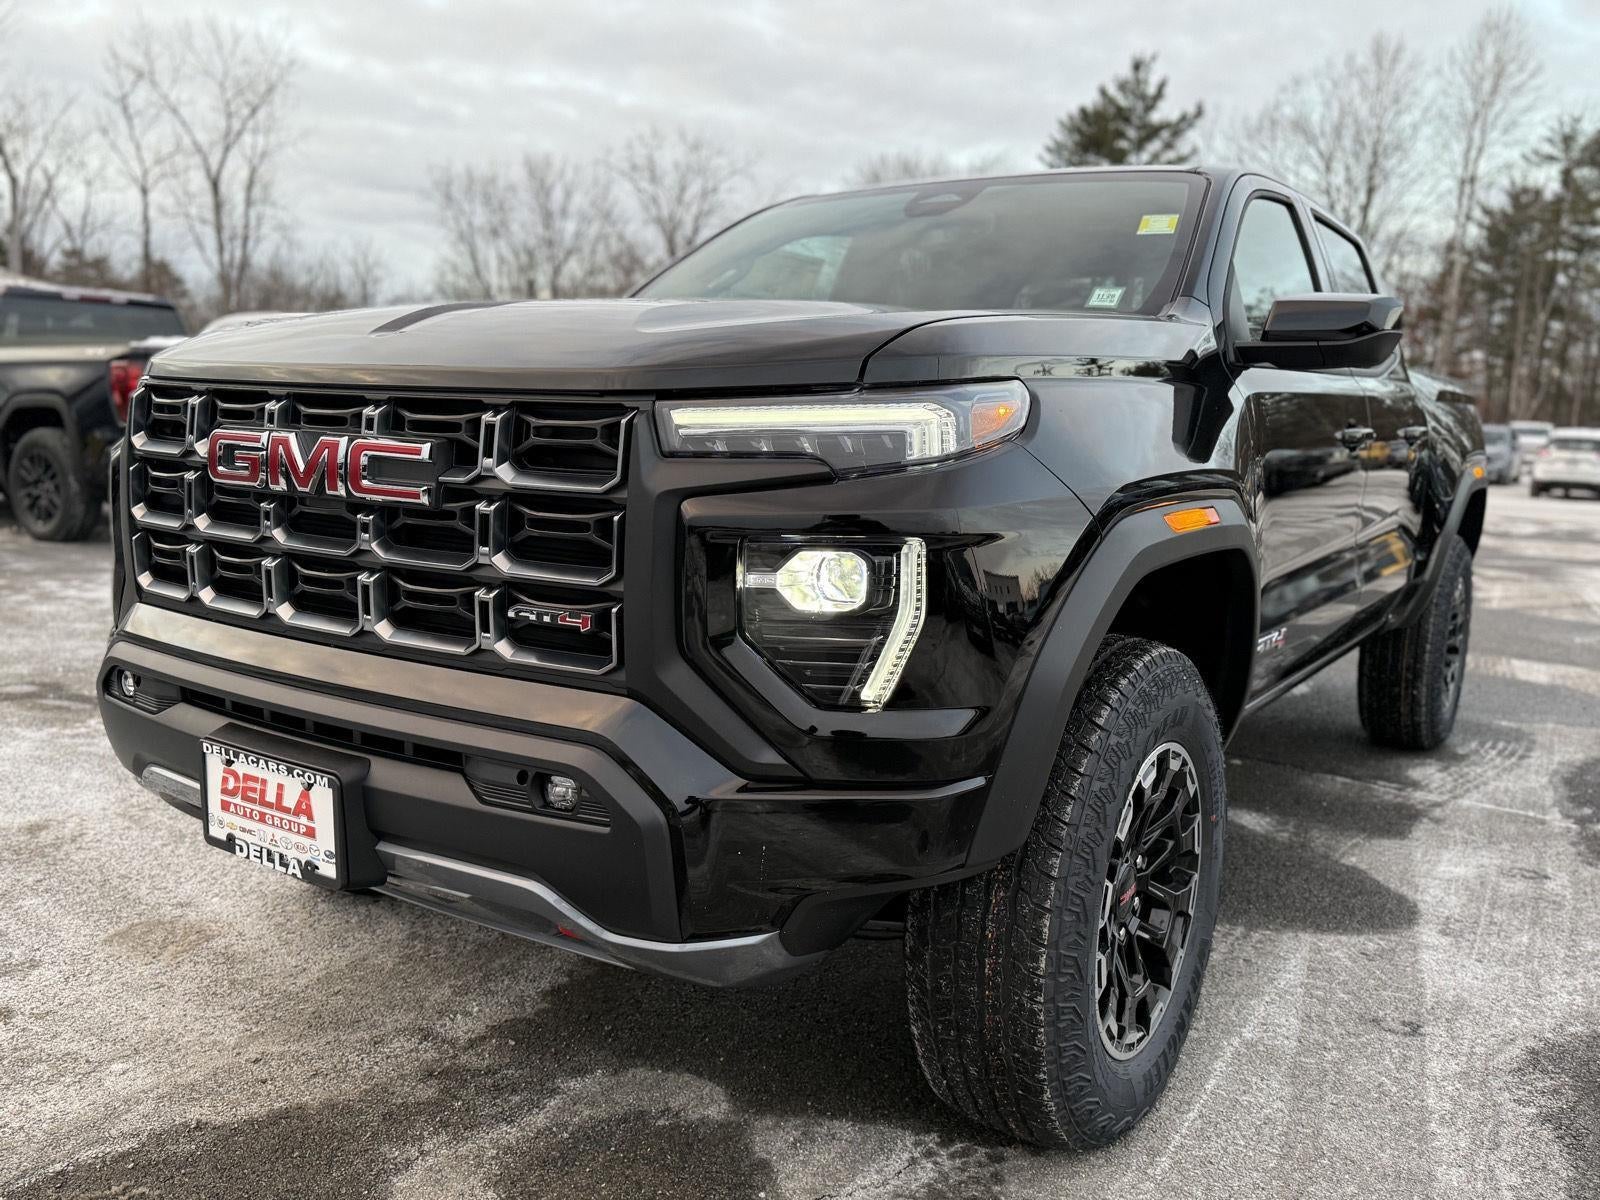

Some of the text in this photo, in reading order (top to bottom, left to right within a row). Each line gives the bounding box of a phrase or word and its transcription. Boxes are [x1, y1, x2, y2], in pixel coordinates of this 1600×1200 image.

[208, 429, 432, 506] GMC
[507, 605, 592, 632] AT4
[203, 742, 329, 788] DELLACARS.COM
[220, 767, 315, 823] DELLA
[229, 803, 307, 835] AUTO GROUP
[234, 838, 303, 879] DELLA
